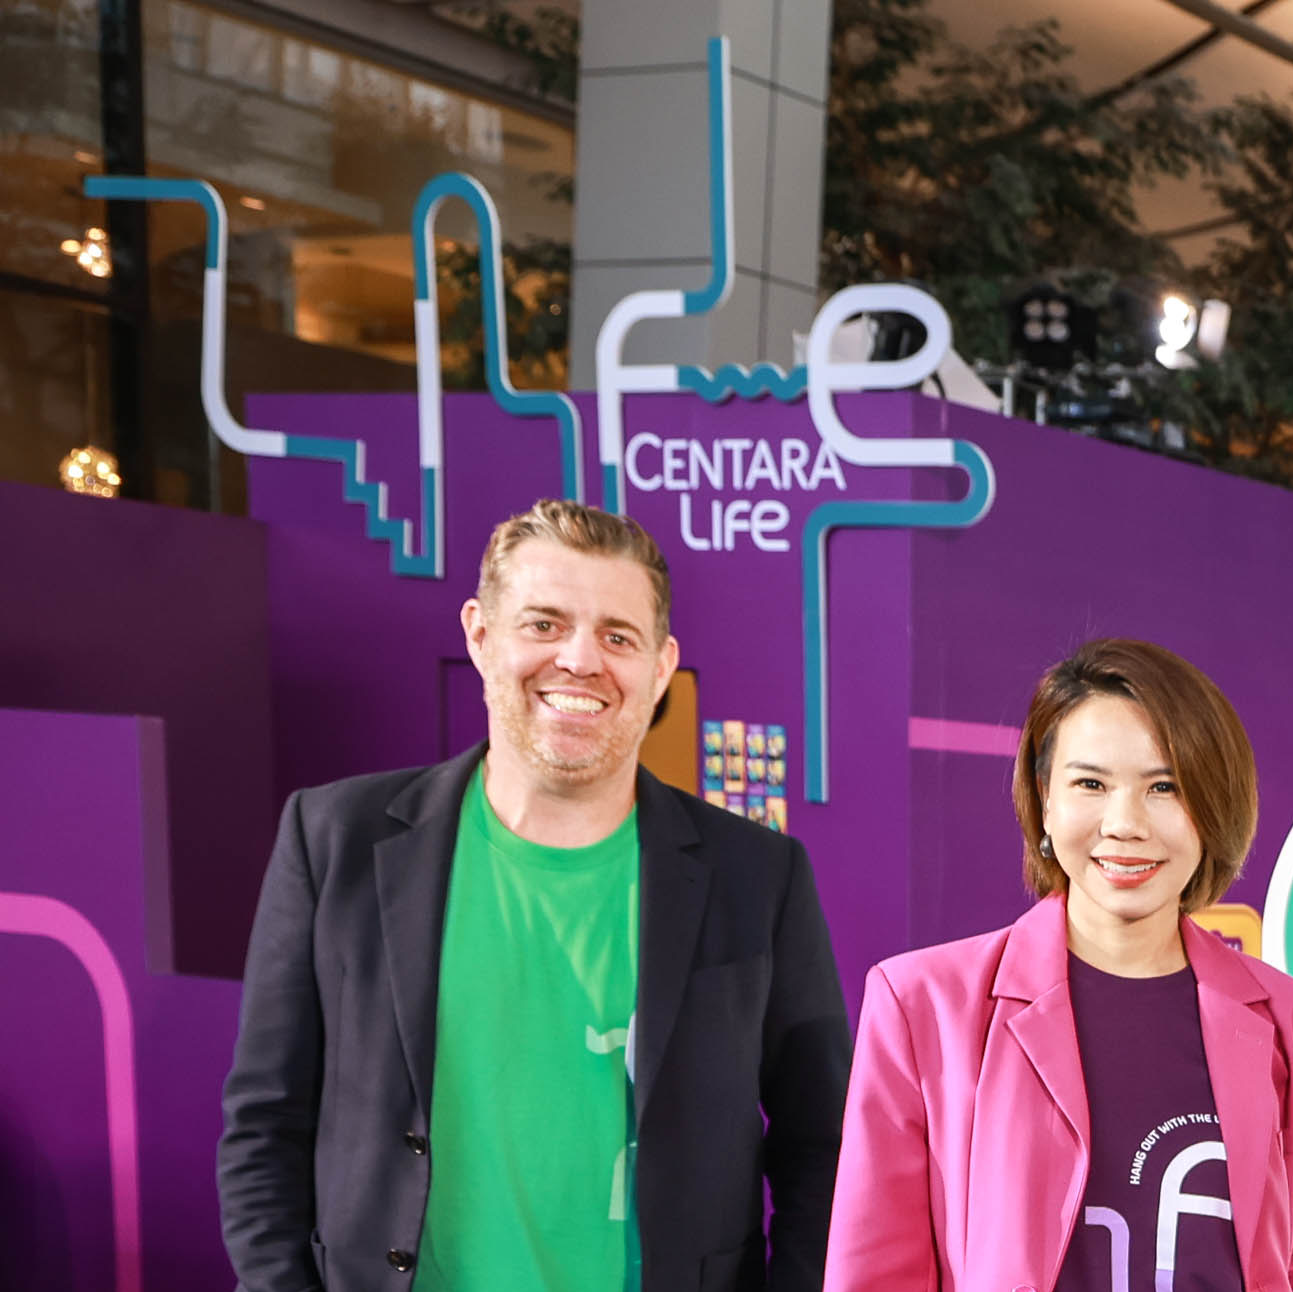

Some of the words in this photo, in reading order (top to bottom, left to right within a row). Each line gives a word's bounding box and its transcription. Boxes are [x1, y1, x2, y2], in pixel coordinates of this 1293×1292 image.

[625, 432, 848, 491] CENTARA
[1130, 1150, 1147, 1185] HANG
[1140, 1129, 1161, 1152] OUT
[1157, 1115, 1188, 1135] WITH
[1187, 1113, 1213, 1124] THE
